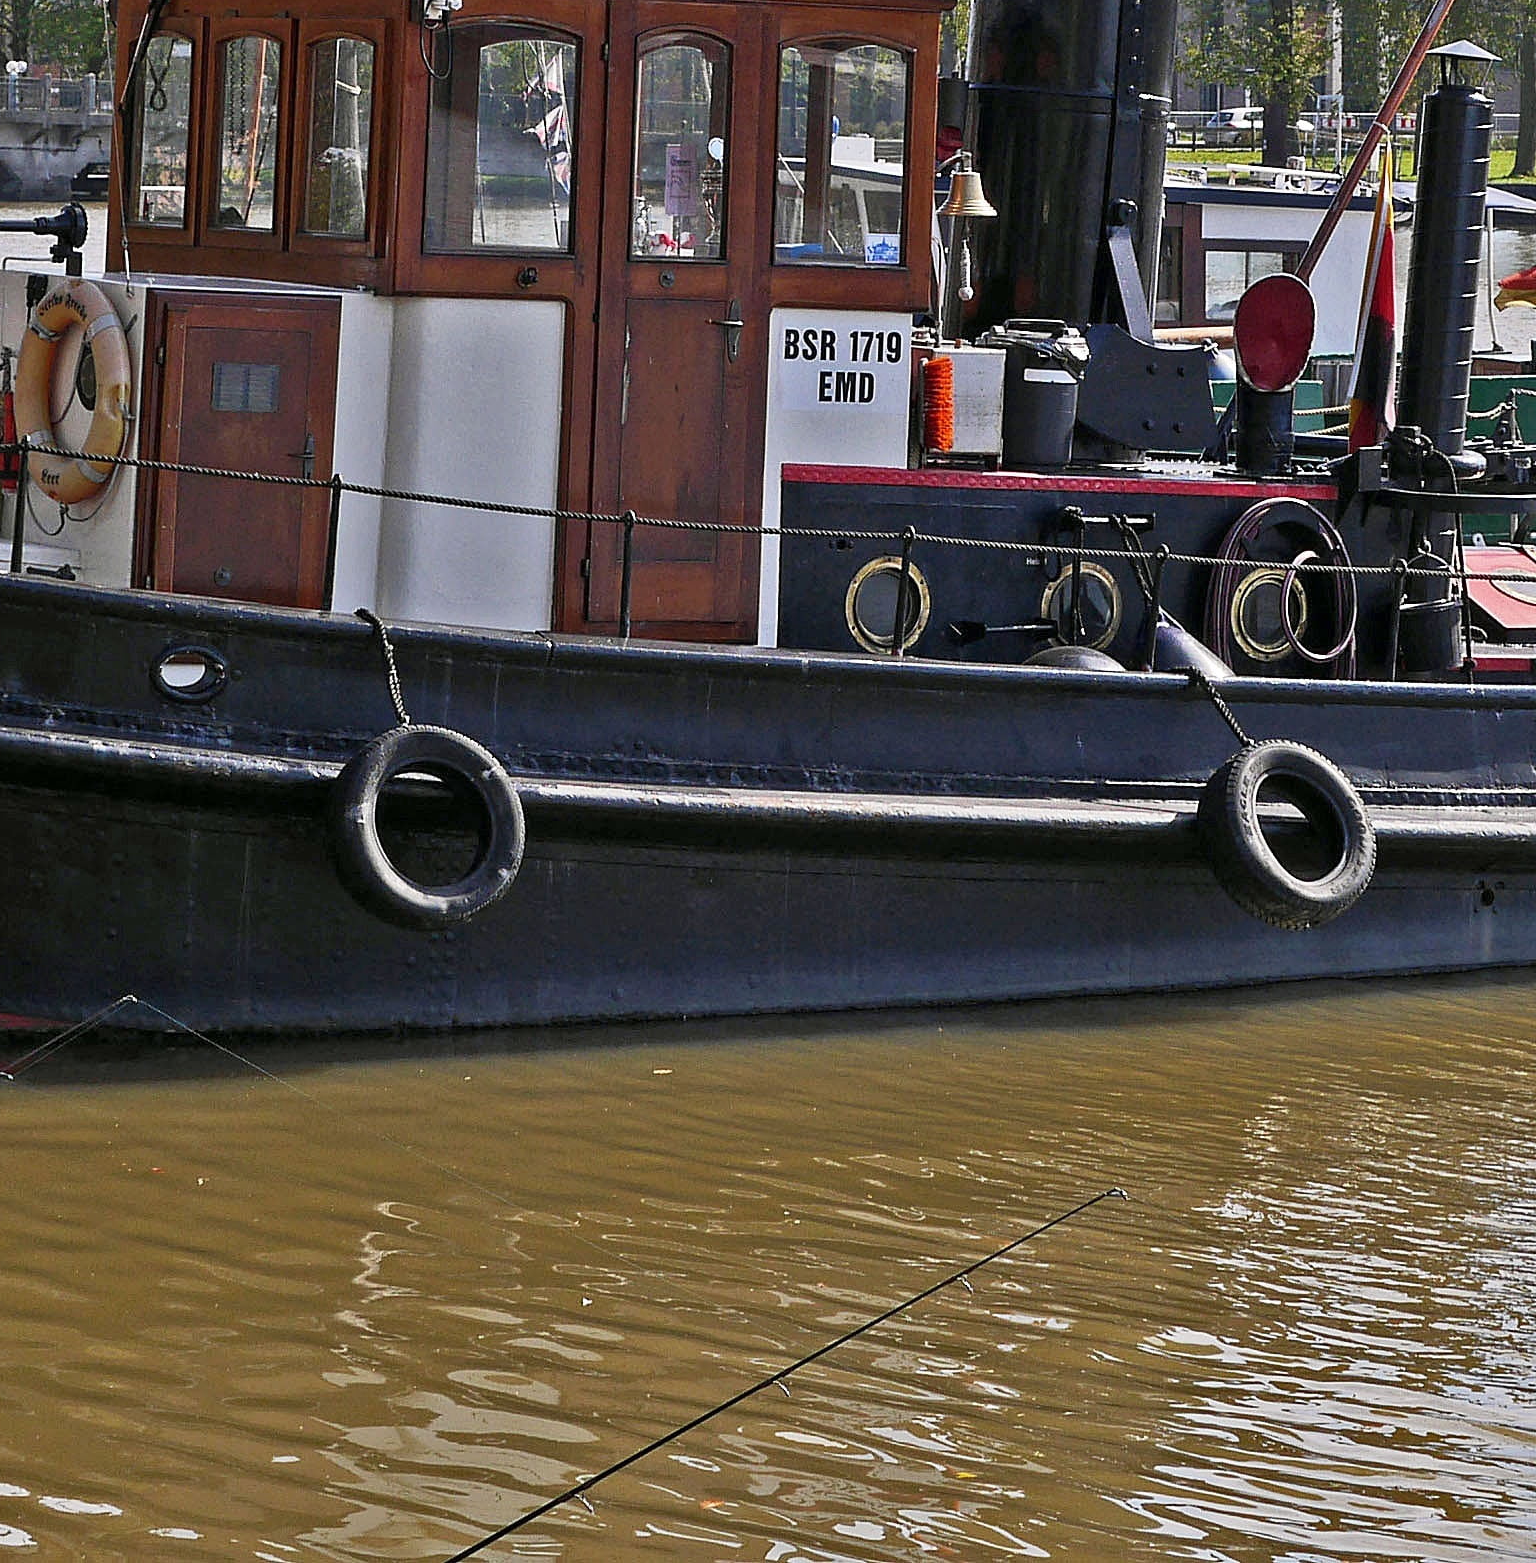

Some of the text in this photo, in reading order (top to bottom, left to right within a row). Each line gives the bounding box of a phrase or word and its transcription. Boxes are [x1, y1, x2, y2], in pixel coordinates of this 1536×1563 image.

[784, 328, 902, 364] BSR 1719
[818, 371, 875, 404] EMD
